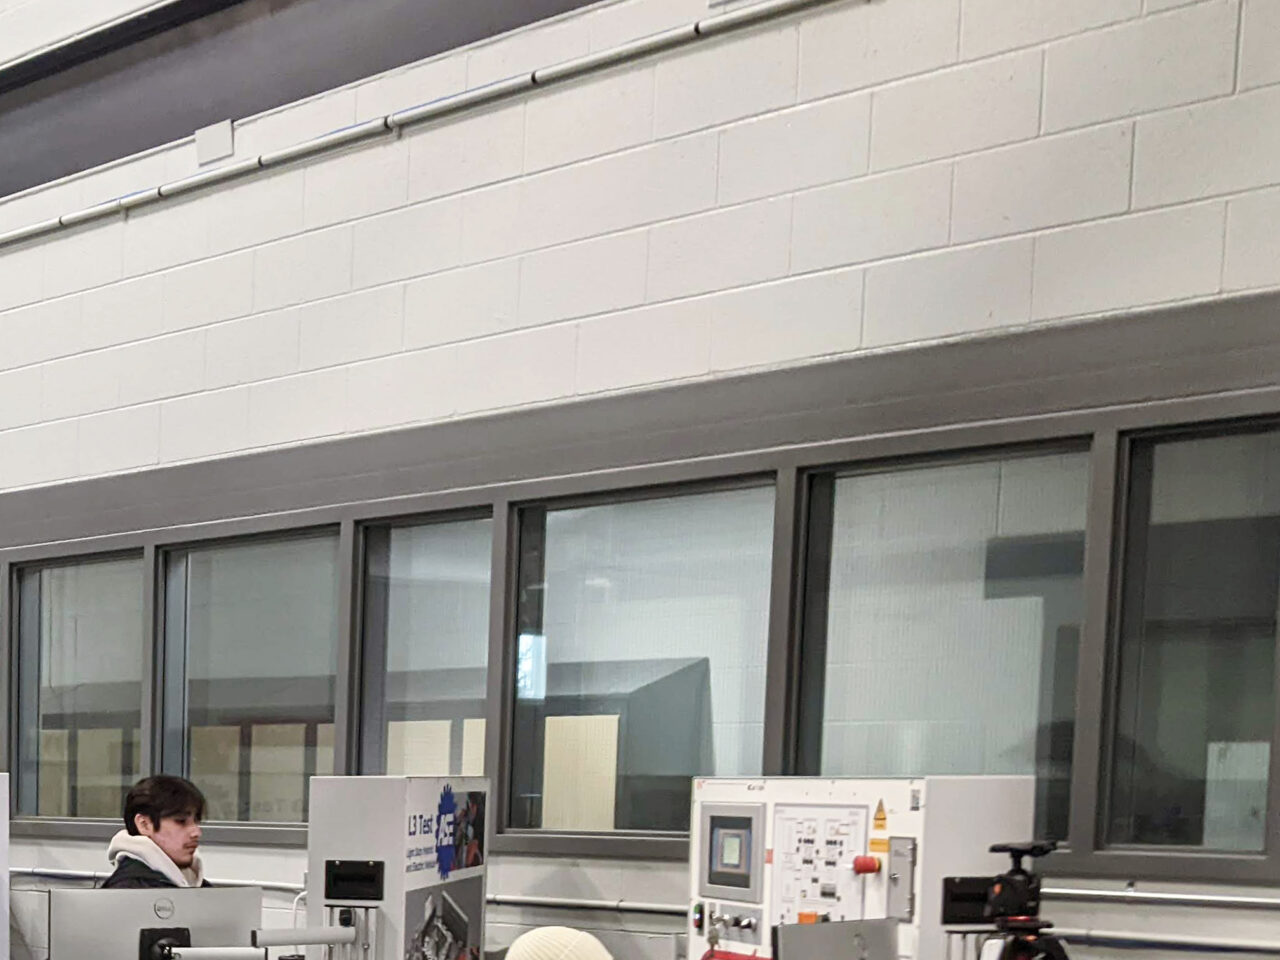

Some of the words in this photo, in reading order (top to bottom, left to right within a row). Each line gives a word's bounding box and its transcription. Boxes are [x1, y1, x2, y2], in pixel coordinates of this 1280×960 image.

[409, 815, 417, 836] L3
[419, 814, 433, 835] Test
[437, 813, 454, 846] ASE
